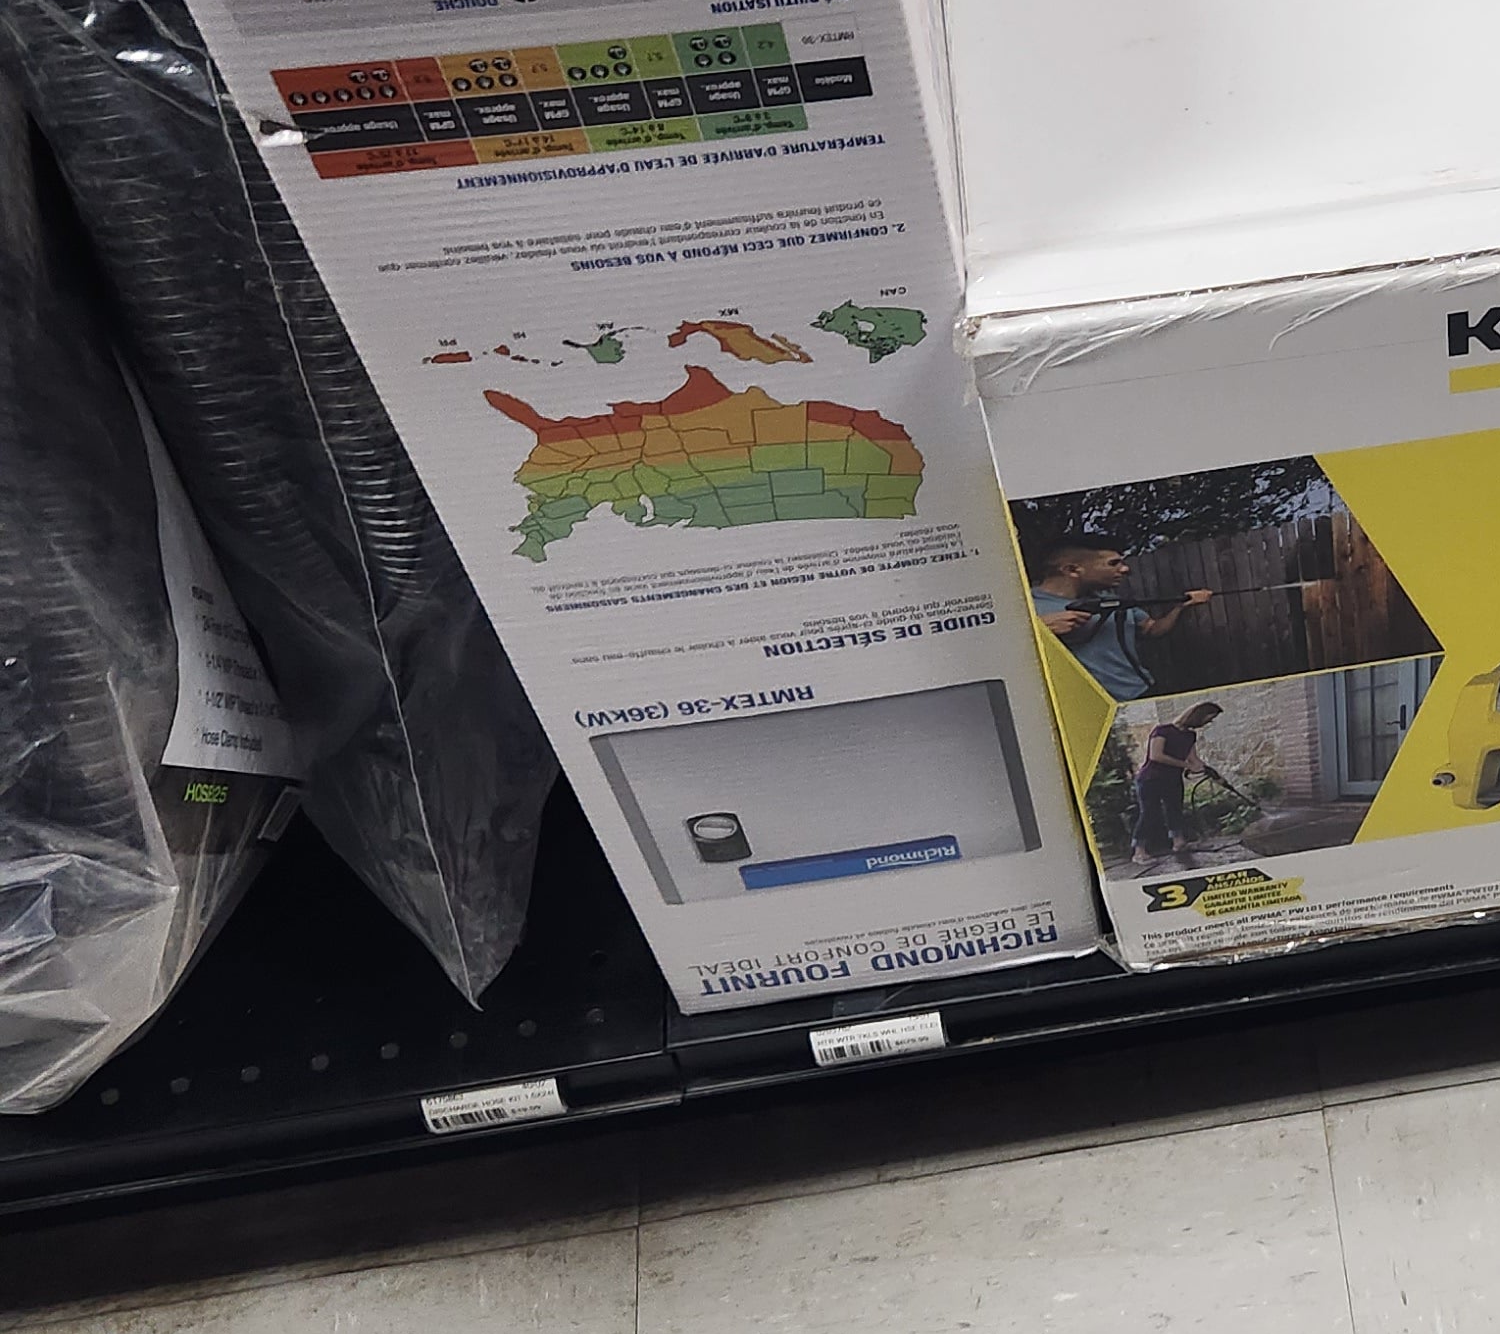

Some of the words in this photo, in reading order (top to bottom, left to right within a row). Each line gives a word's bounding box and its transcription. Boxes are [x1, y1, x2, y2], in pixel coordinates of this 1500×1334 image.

[780, 133, 885, 155] TEMPÉRATURE
[678, 155, 698, 166] DE
[702, 145, 777, 165] D'ARRIVÉE
[633, 157, 674, 173] L'EAU
[456, 161, 630, 189] D'APPROVISIONNEMENT
[778, 236, 805, 247] QUE
[809, 224, 888, 244] CONFIRMEZ
[681, 243, 739, 262] RÉPOND
[742, 239, 774, 252] CECI
[570, 255, 631, 272] BESOINS
[635, 252, 665, 265] VOS
[879, 285, 907, 298] CAN
[879, 556, 927, 571] COMPTE
[930, 550, 967, 564] TENEZ
[818, 567, 857, 580] VOTRE
[860, 564, 875, 574] DE
[724, 583, 749, 593] DES
[753, 580, 767, 589] ET
[770, 573, 815, 588] RÉGION
[630, 585, 722, 603] CHANGEMENTS
[928, 611, 996, 634] GUIDE
[892, 624, 923, 640] DE
[762, 629, 887, 658] SÉLECTION
[677, 684, 815, 717] RMTEX-36
[573, 701, 670, 729] (36kW)
[184, 783, 228, 803] HOSE25
[864, 845, 957, 869] Richmond
[1205, 871, 1248, 883] YEAR
[1158, 885, 1188, 907] 3
[1202, 891, 1237, 902] LIMITED
[1239, 882, 1288, 895] WARRANTY
[1026, 909, 1055, 926] LE
[1141, 932, 1161, 941] This
[1164, 926, 1202, 939] product
[1204, 921, 1235, 932] meets
[1236, 917, 1249, 925] all
[1288, 904, 1323, 915] PW101
[1326, 894, 1387, 910] performance
[1389, 883, 1455, 901] requirements
[937, 917, 1016, 945] DEGRÉ
[870, 924, 1059, 973] RICHMOND
[894, 933, 927, 951] DE
[773, 939, 886, 967] CONFORT
[687, 957, 762, 979] IDÉAL
[699, 959, 852, 997] FOURNIT
